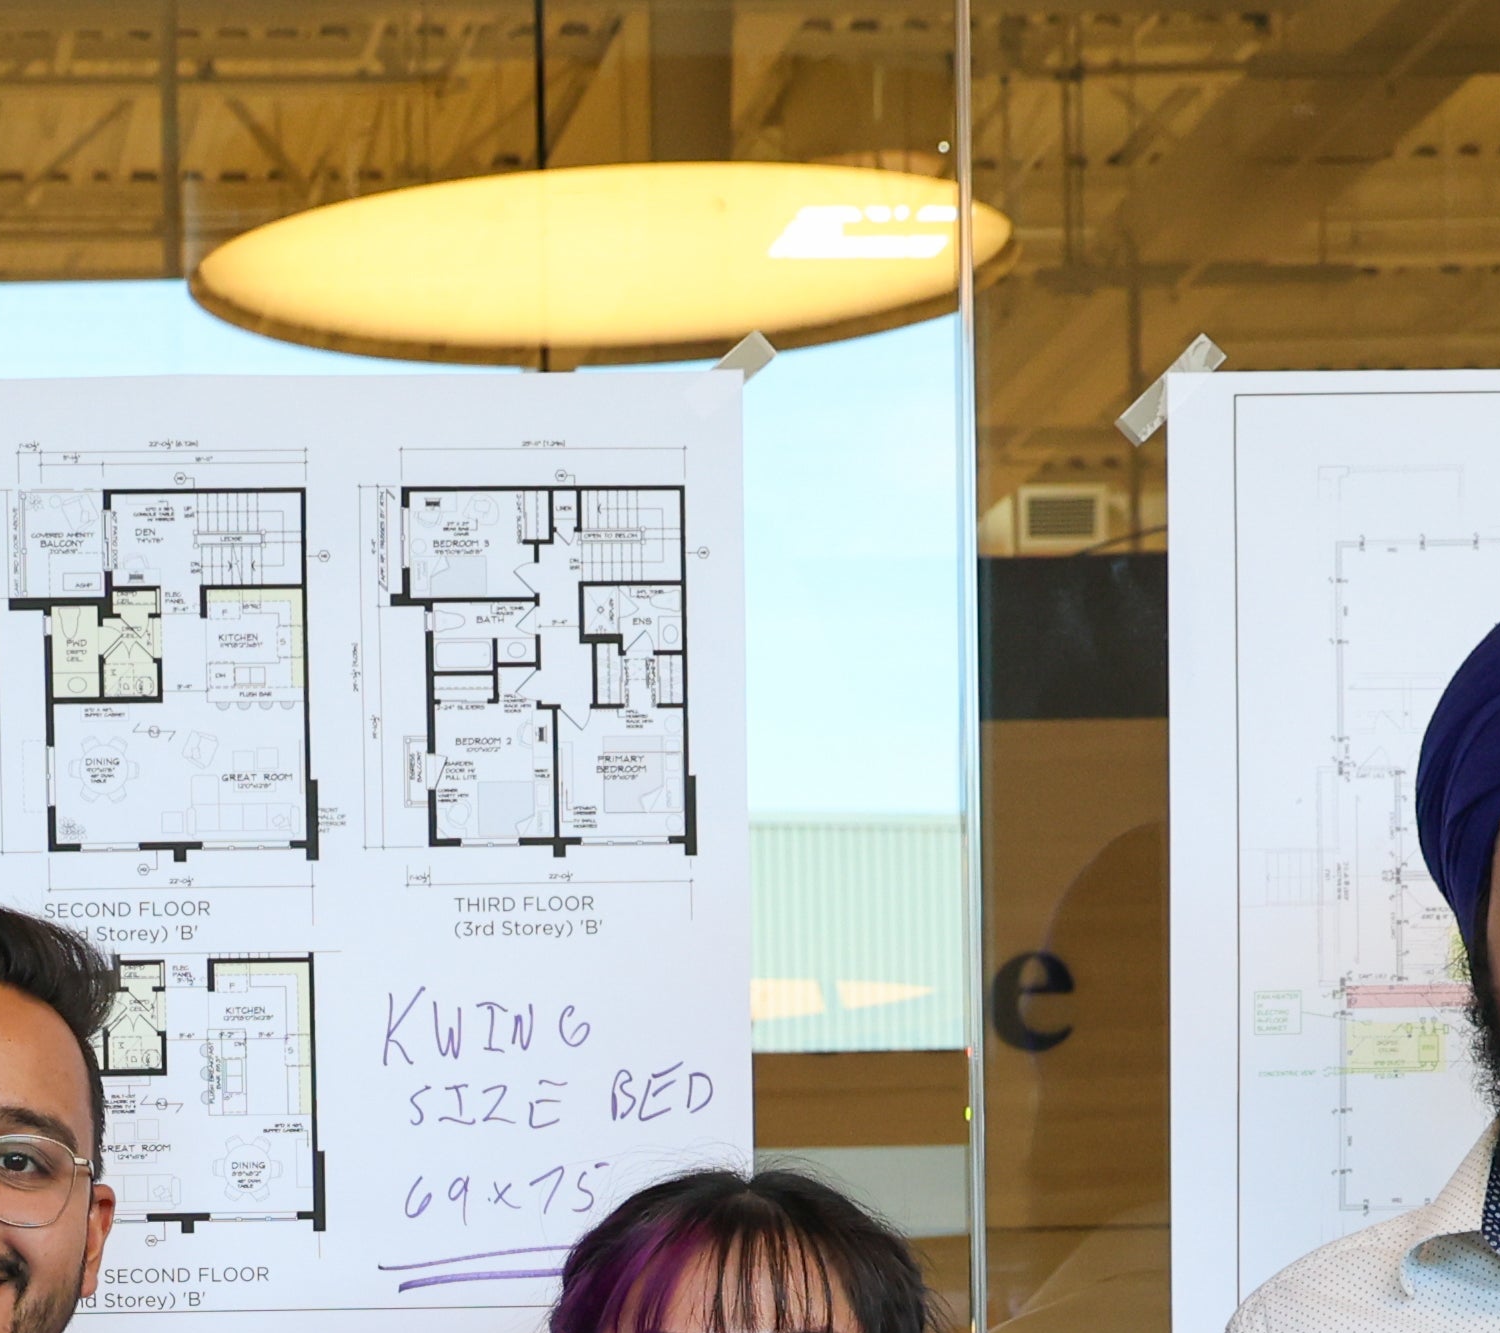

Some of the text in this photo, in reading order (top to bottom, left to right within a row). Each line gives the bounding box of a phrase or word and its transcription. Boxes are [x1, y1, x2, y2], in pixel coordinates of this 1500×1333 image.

[476, 616, 505, 624] BATH
[597, 755, 644, 763] PRIMARY
[596, 765, 647, 774] BEDROOM
[44, 900, 211, 919] SECOND FLOOR
[454, 895, 594, 913] THIRD FLOOR
[96, 925, 198, 943] Storey) 'B'
[454, 918, 603, 938] (3rd Storey) 'B'
[410, 1061, 713, 1128] SIZE BED
[104, 1266, 270, 1284] SECOND FLOOR
[104, 1290, 207, 1311] Storey) 'B'
